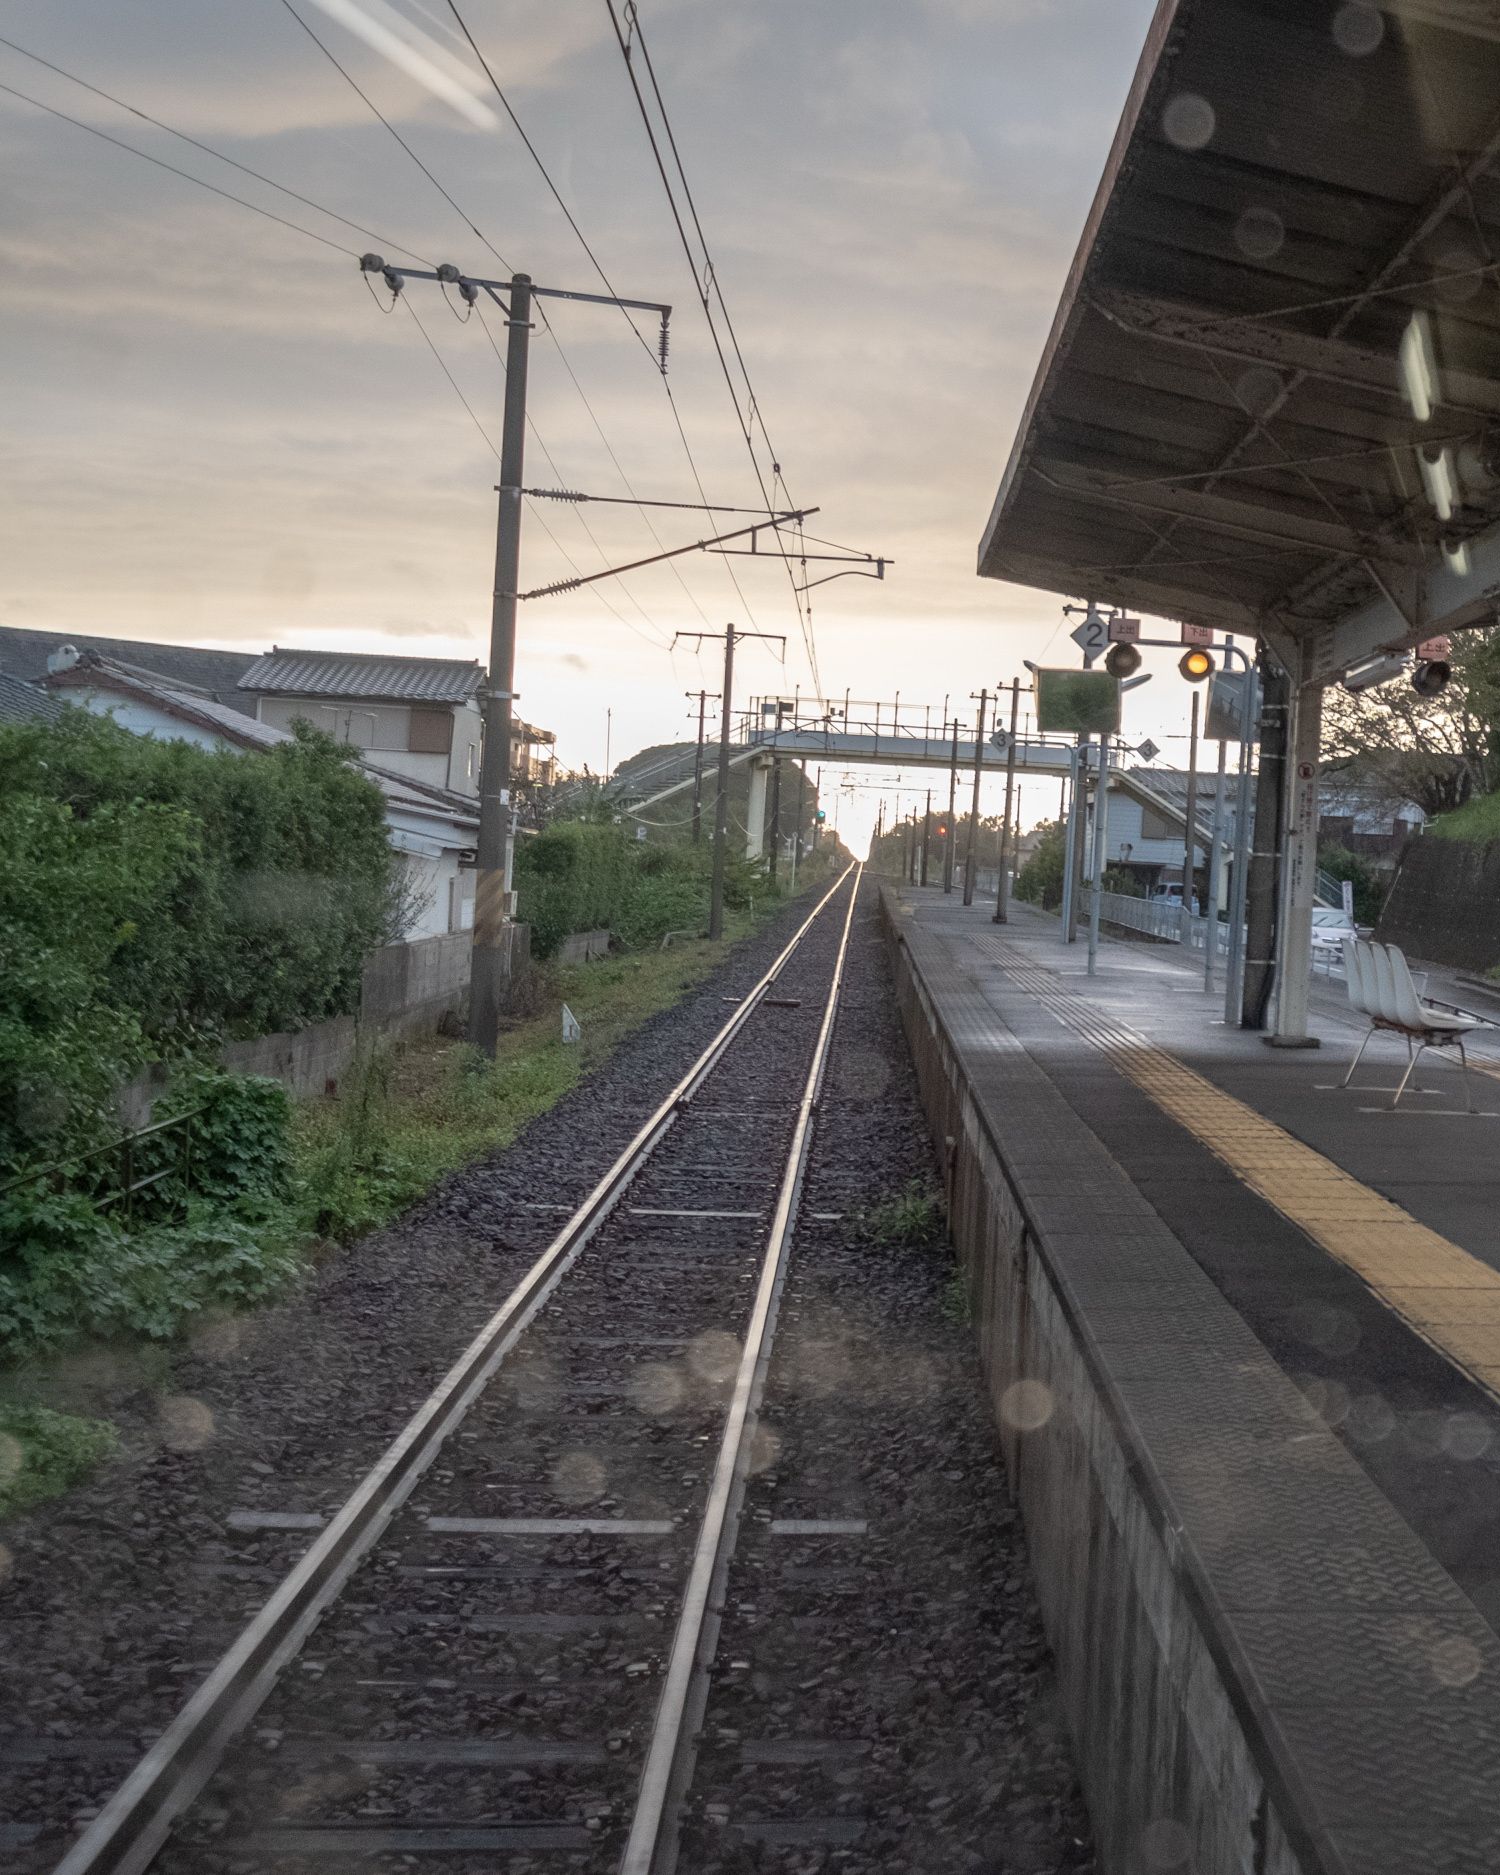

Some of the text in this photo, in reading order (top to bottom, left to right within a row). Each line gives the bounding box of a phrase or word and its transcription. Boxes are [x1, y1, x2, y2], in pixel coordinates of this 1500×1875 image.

[1086, 622, 1103, 648] 2
[996, 733, 1007, 747] 3
[1143, 743, 1153, 757] 3
